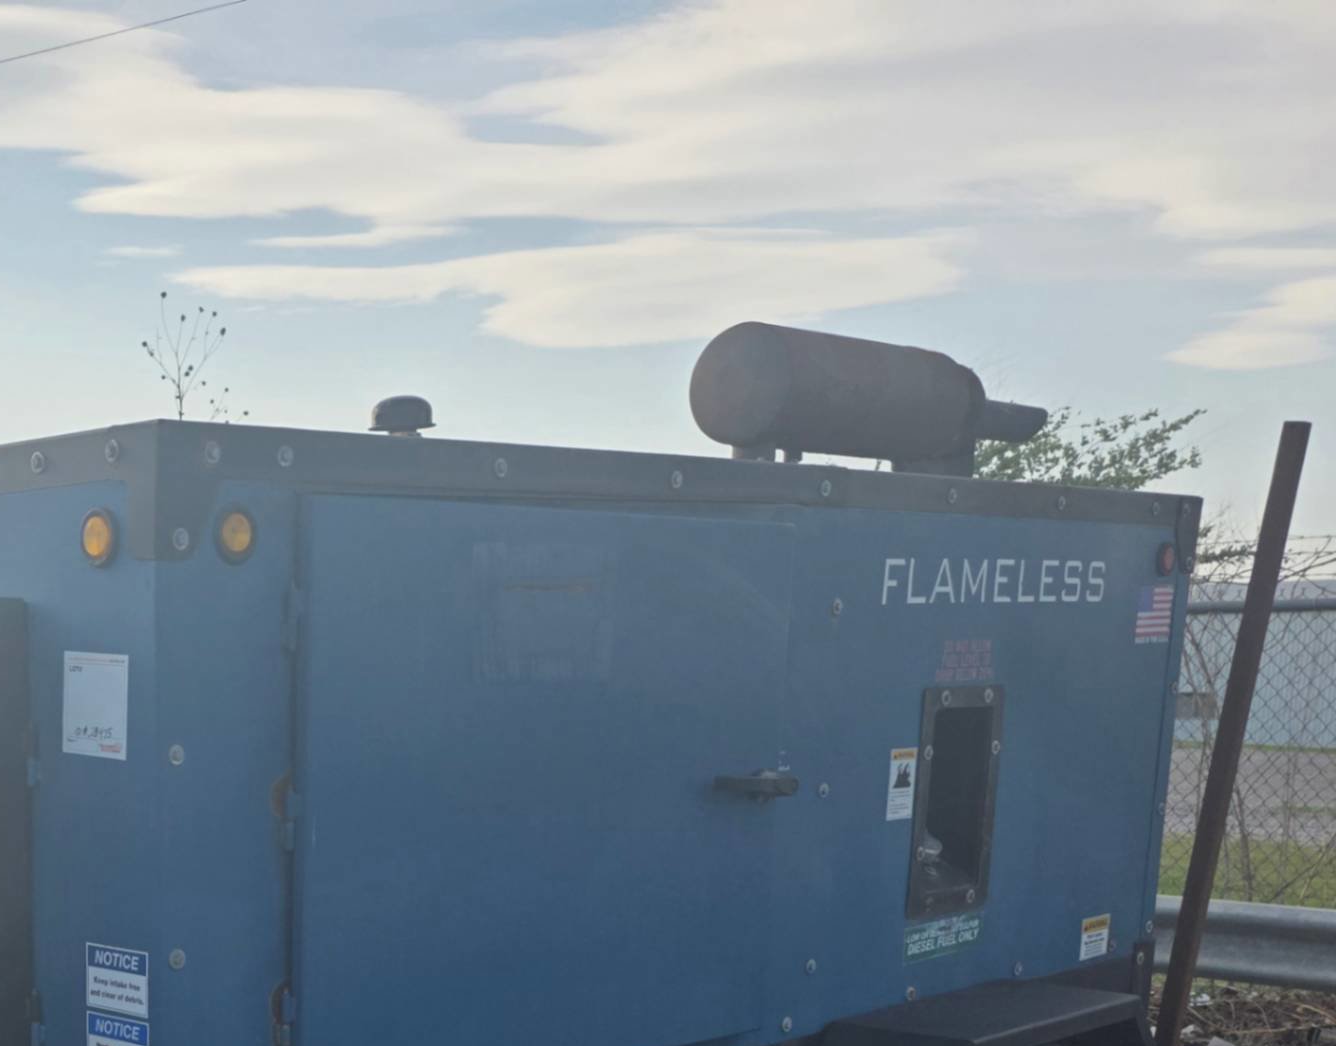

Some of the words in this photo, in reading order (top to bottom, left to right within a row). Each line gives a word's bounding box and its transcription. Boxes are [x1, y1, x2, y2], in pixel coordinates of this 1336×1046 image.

[880, 556, 1106, 606] FLAMELESS
[907, 938, 937, 956] DIESEL
[937, 934, 958, 949] FUEL
[958, 927, 980, 944] ONLY
[94, 949, 139, 971] NOTICE
[90, 988, 101, 997] and
[102, 990, 116, 1000] clear
[93, 976, 108, 987] Keep
[110, 979, 128, 990] intake
[95, 1017, 141, 1041] NOTICE
